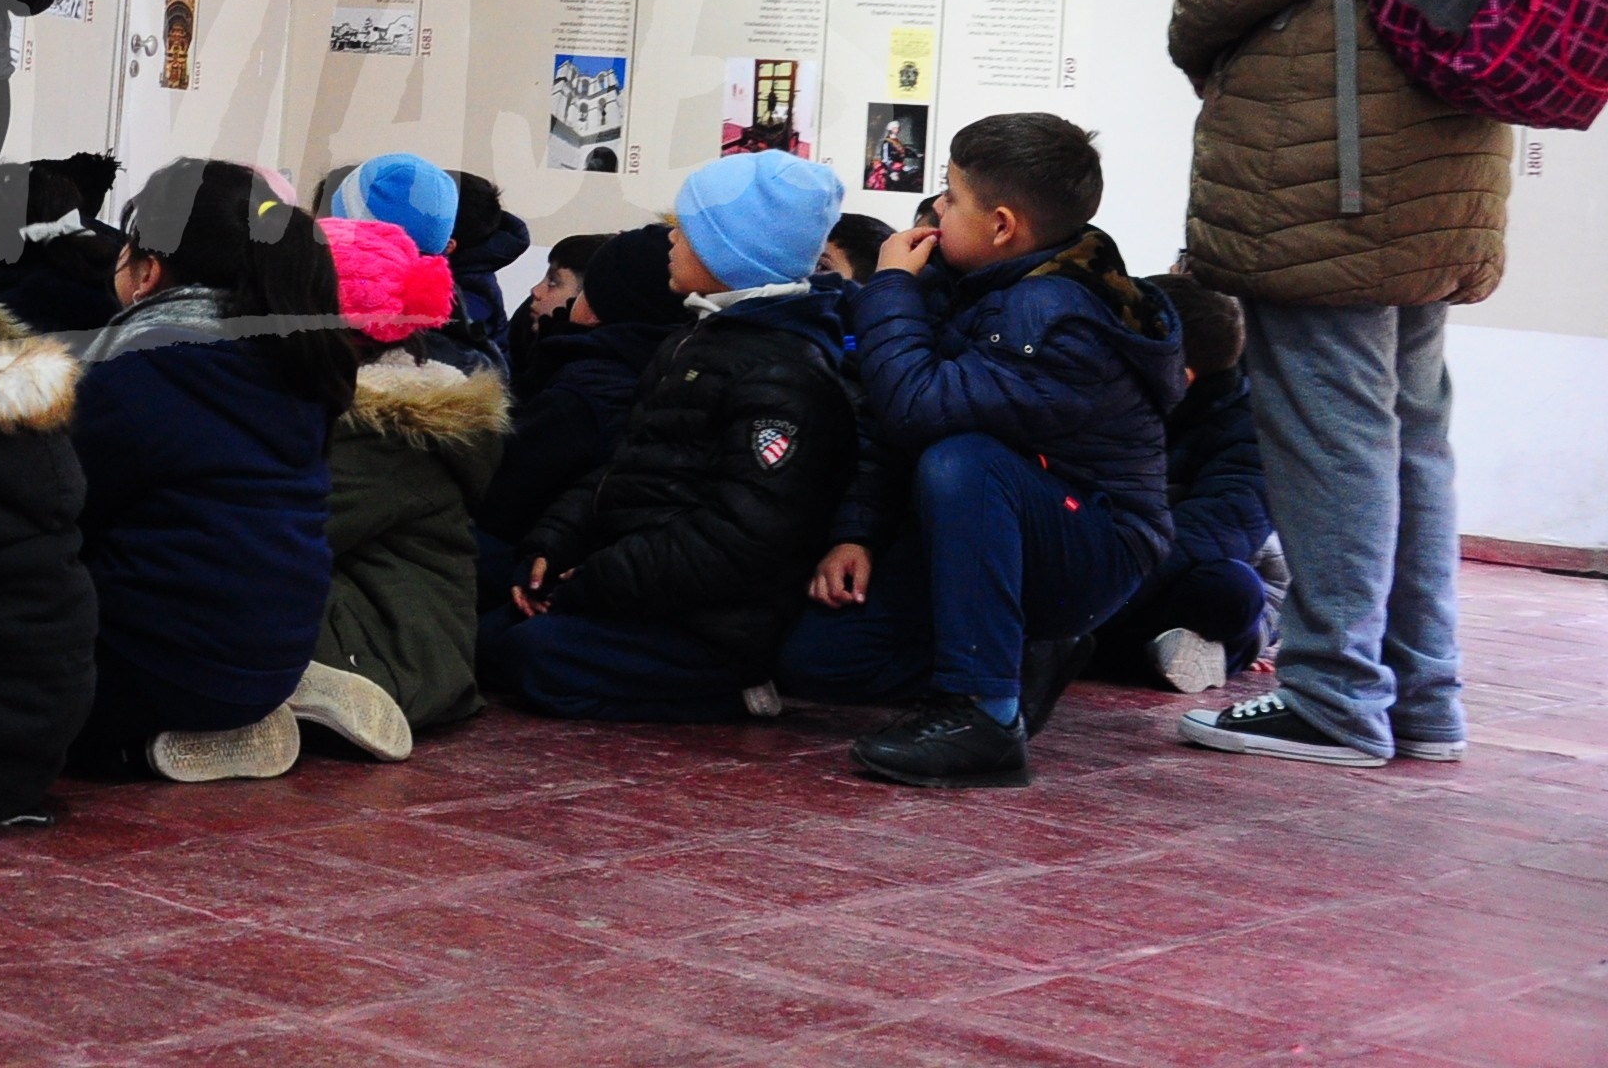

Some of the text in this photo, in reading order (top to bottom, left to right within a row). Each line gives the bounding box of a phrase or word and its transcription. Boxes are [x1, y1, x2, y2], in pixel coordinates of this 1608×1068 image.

[421, 28, 433, 57] 1683
[1064, 57, 1076, 88] 1769
[629, 145, 641, 174] 1693
[1527, 142, 1541, 175] 1800
[753, 419, 798, 436] Strong
